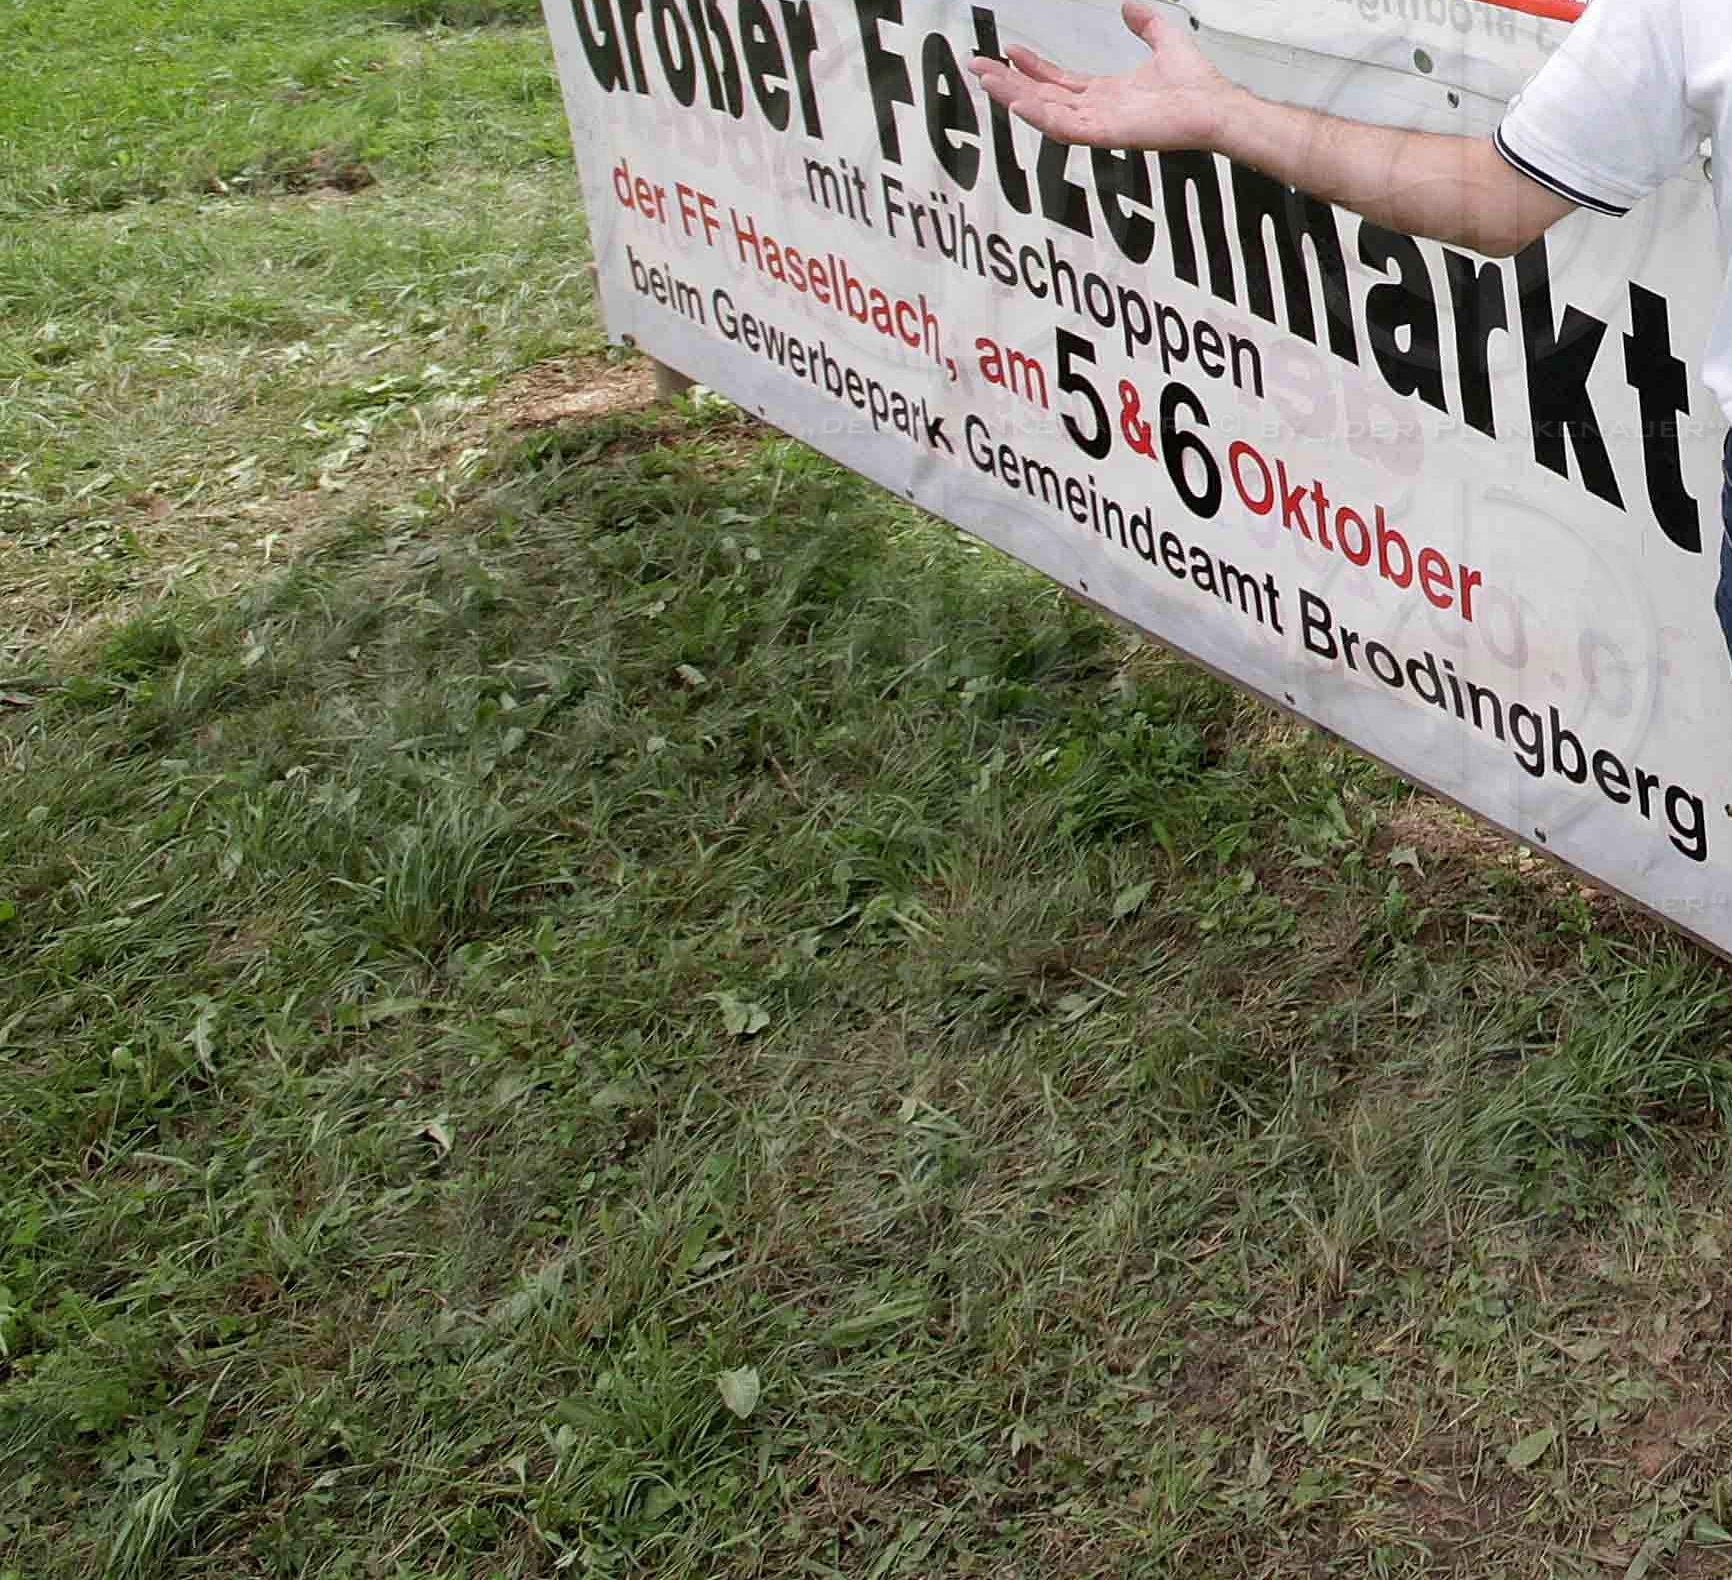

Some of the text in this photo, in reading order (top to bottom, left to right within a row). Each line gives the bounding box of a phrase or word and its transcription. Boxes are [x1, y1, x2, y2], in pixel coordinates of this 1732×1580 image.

[612, 157, 665, 226] der
[675, 181, 720, 245] FF
[730, 206, 957, 382] Haselbach,
[975, 337, 1048, 409] am
[1229, 440, 1482, 622] Oktober
[803, 156, 1264, 398] mit Frühschoppen
[626, 245, 1708, 863] beim Gewerbepark Gemeindeamt Brodingberg
